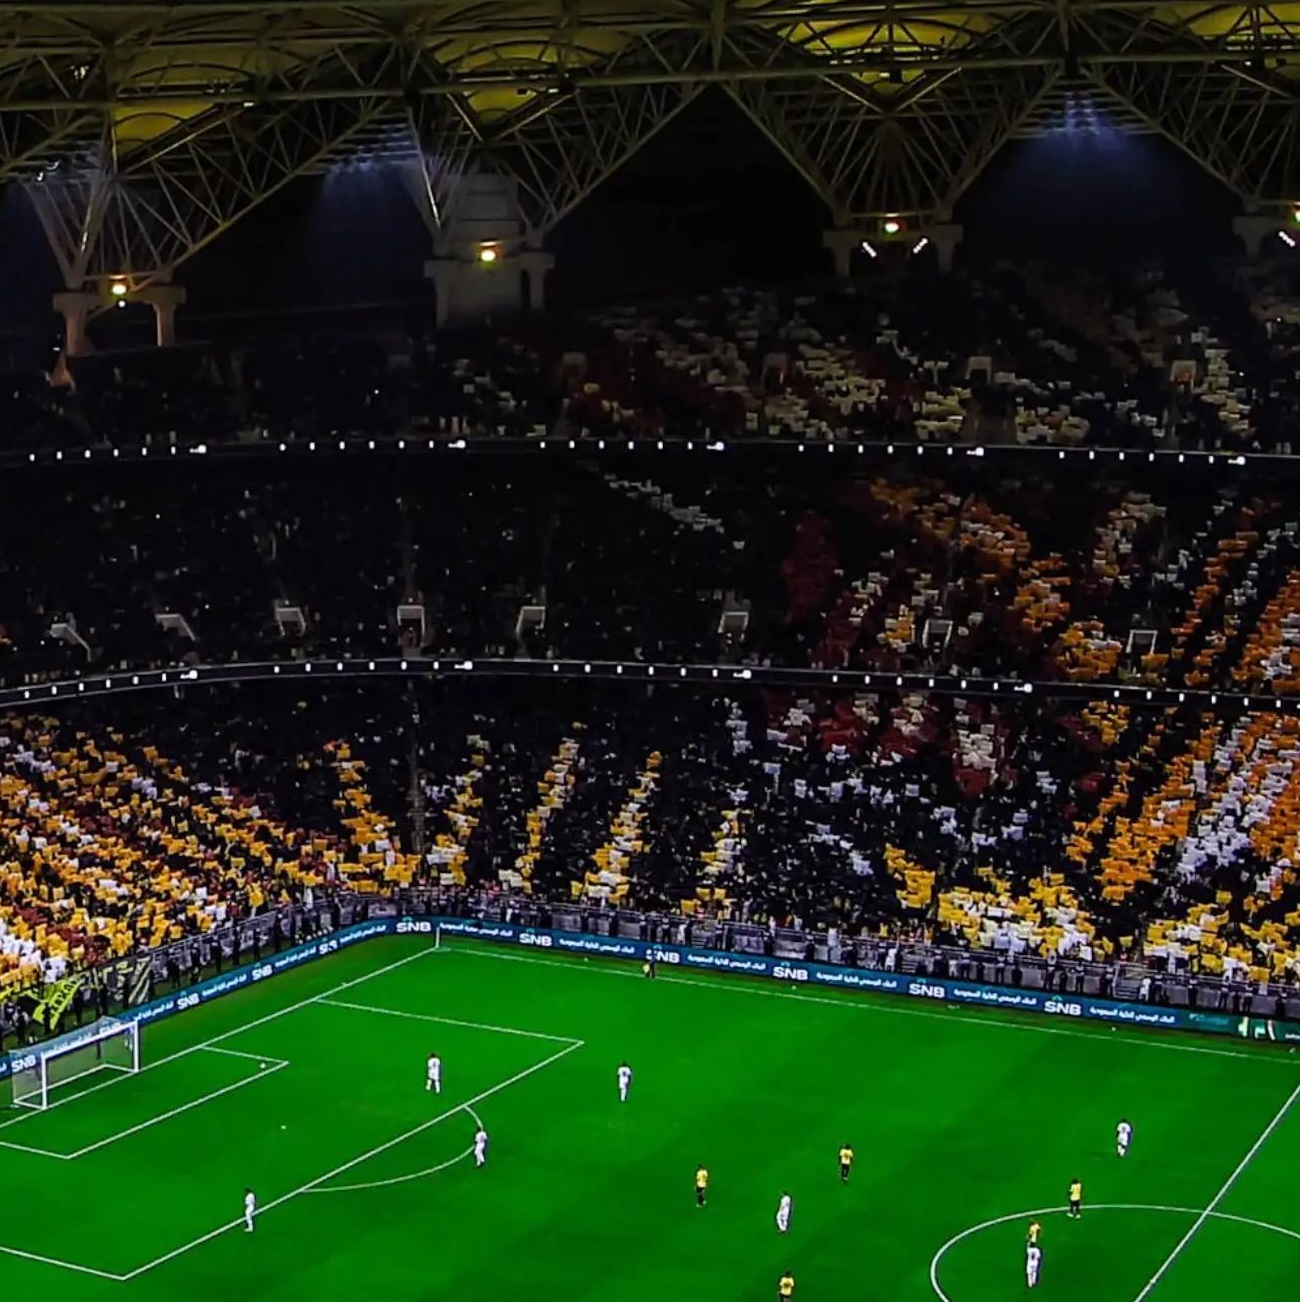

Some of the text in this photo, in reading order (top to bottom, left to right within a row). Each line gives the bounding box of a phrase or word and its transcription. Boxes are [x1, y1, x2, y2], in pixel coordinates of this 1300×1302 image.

[397, 921, 432, 932] SNB
[520, 934, 553, 946] SNB
[319, 941, 338, 954] SB
[773, 965, 809, 980] SNB
[909, 984, 946, 998] SNB
[1045, 1001, 1082, 1015] SNB
